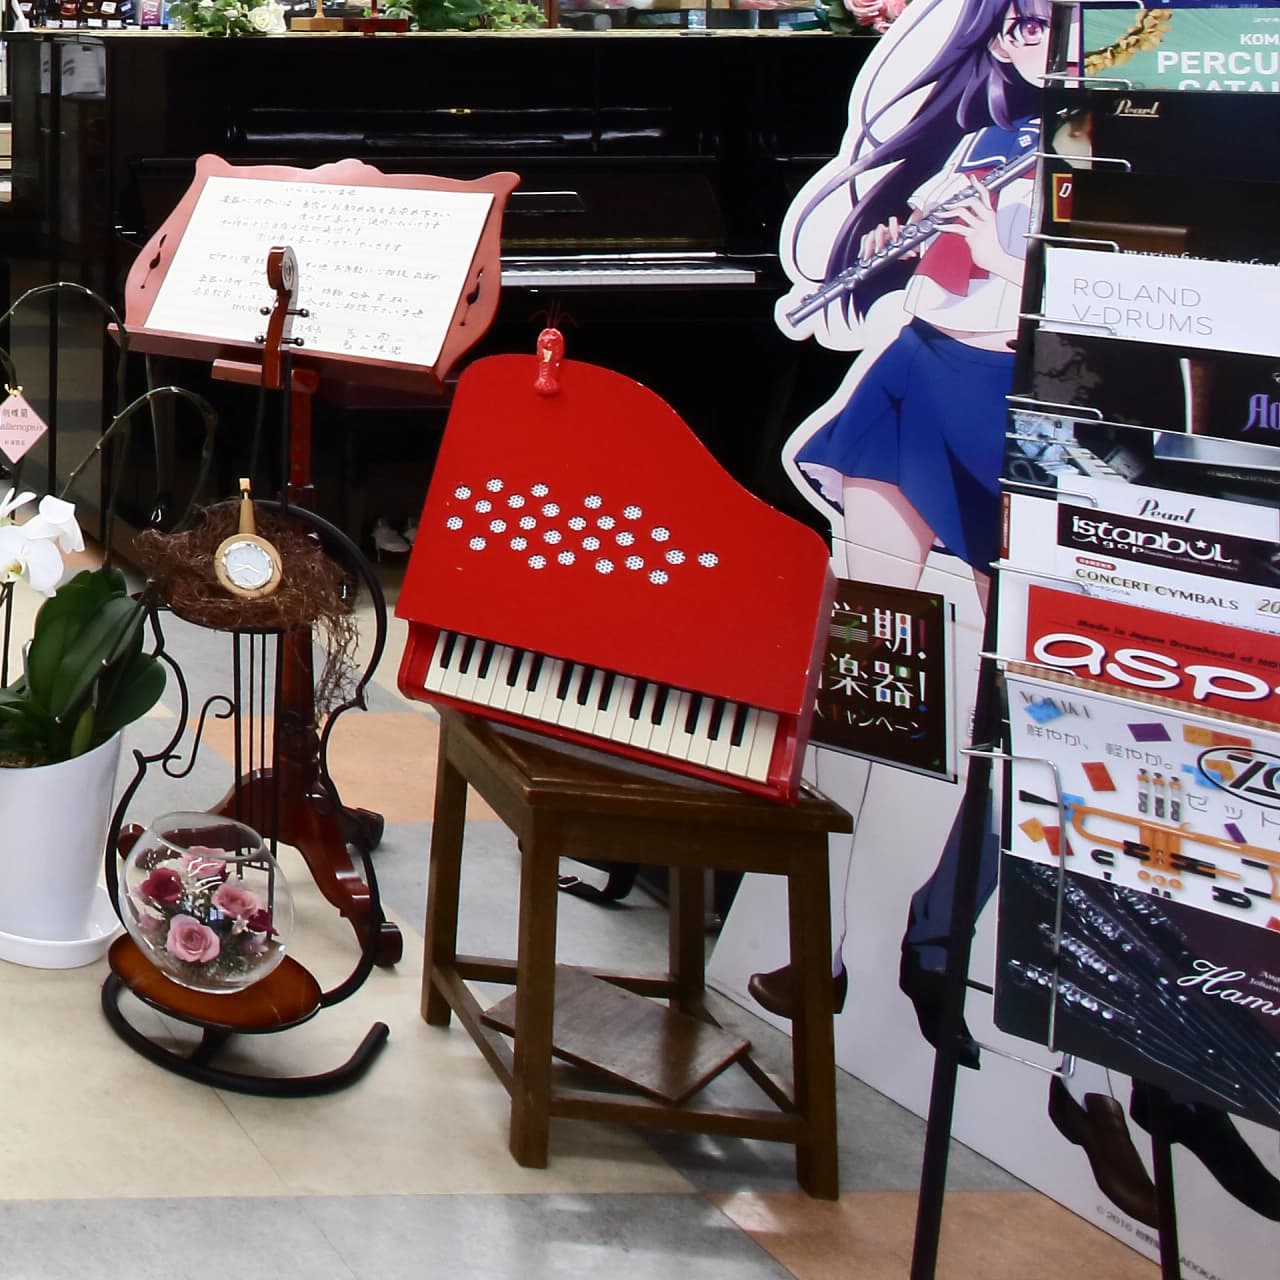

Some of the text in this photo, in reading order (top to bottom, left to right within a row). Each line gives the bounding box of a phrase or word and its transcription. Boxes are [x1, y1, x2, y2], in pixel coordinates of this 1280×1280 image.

[1157, 51, 1279, 75] PERCU
[1114, 98, 1160, 117] Pearl
[1073, 278, 1202, 308] ROLAND
[1072, 303, 1214, 336] V-DRUMS
[1138, 497, 1197, 525] Pearl
[1075, 568, 1152, 592] CONCERT
[1154, 585, 1240, 611] CYMBALS
[1033, 631, 1280, 702] asp
[1177, 959, 1280, 1016] Ham
